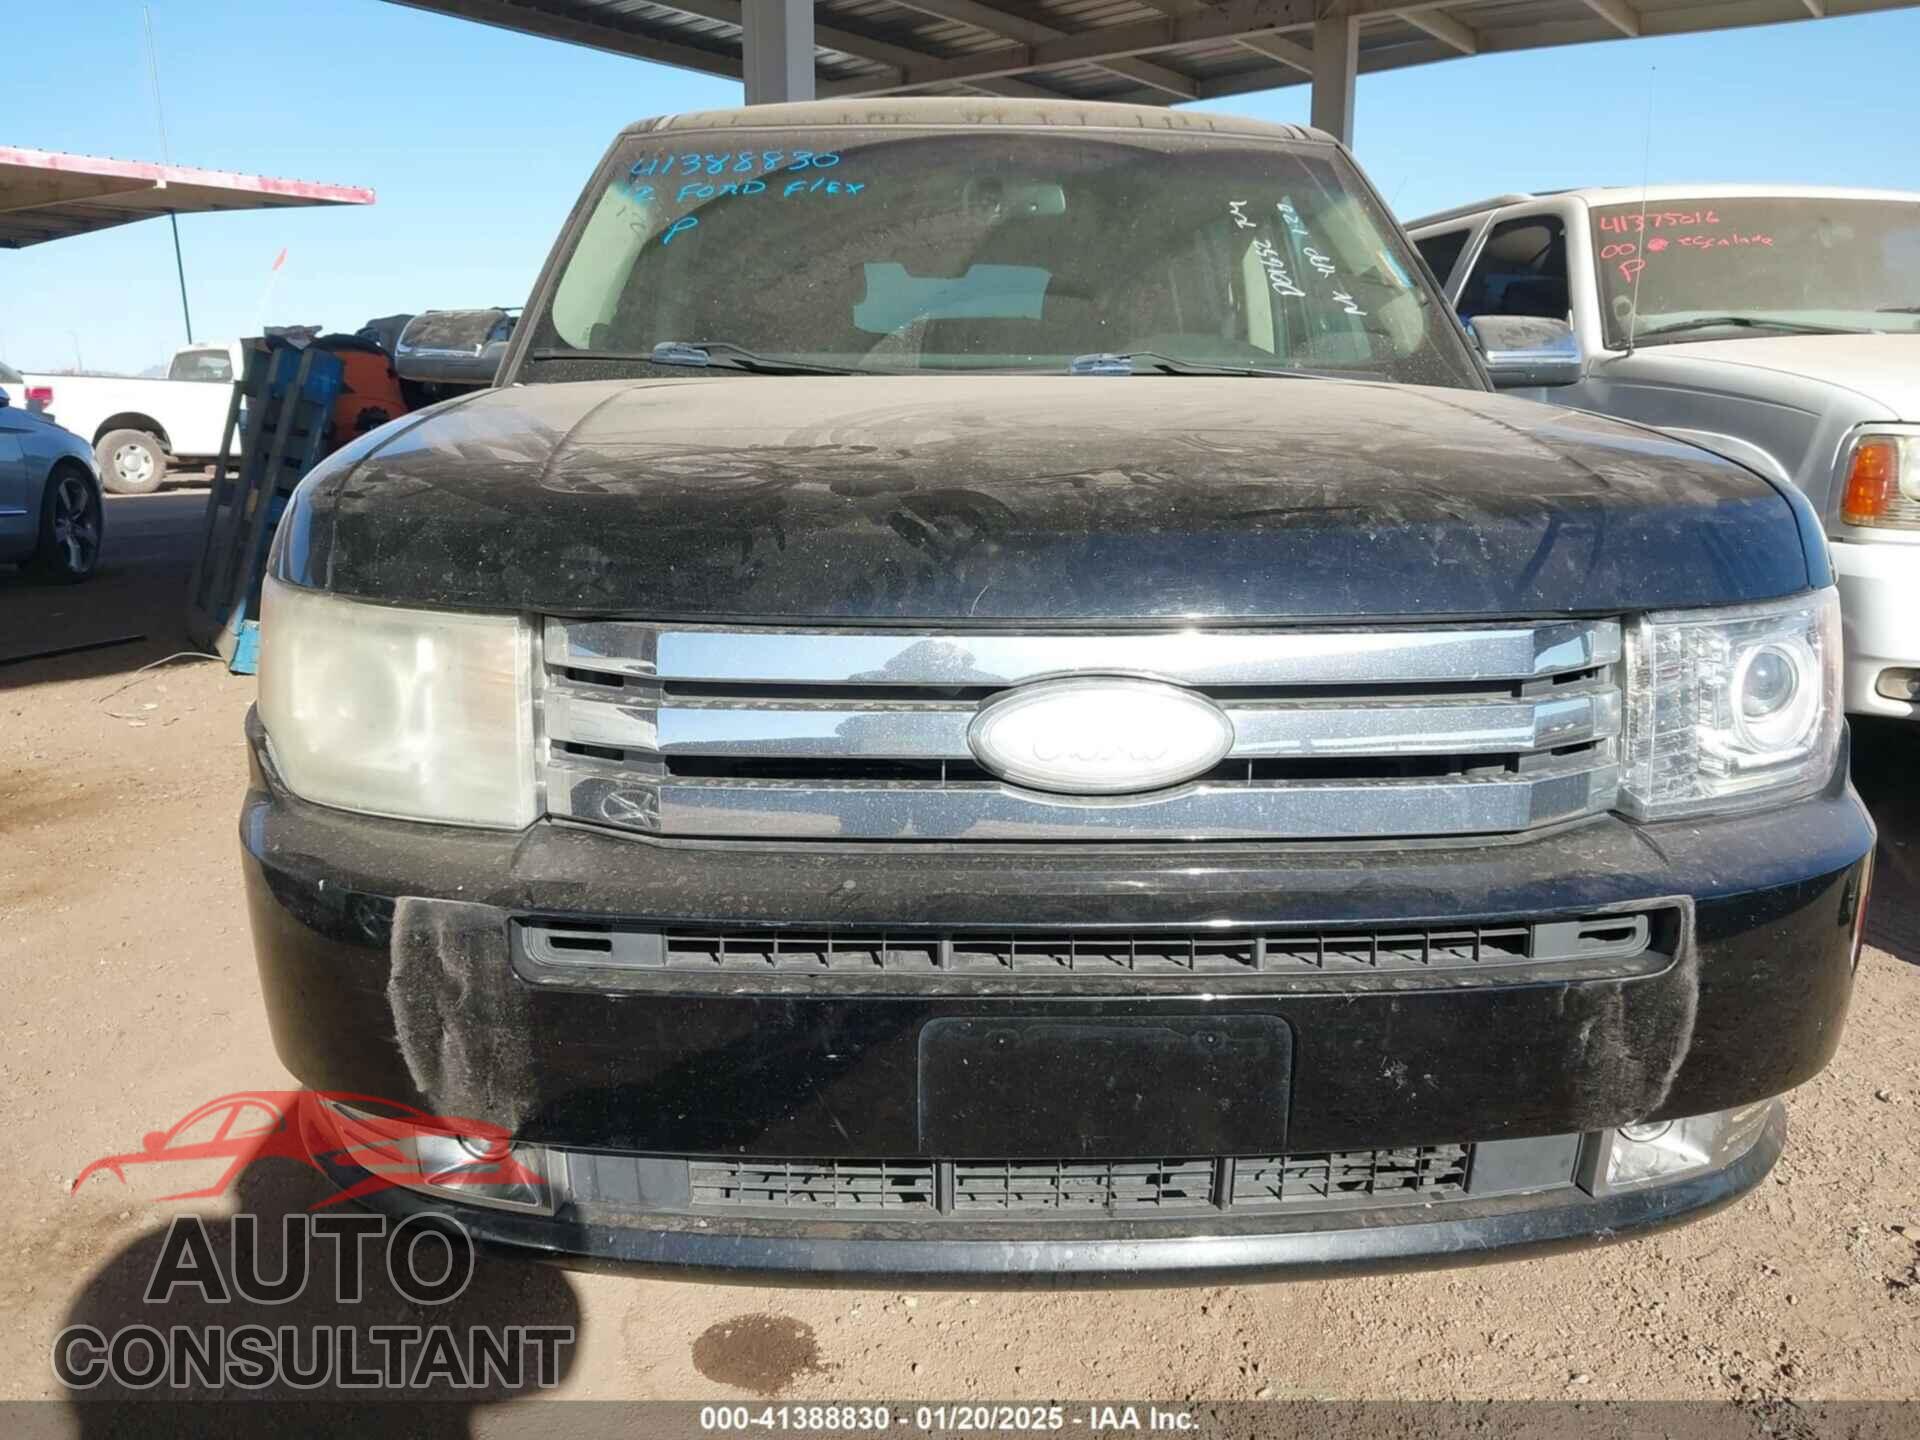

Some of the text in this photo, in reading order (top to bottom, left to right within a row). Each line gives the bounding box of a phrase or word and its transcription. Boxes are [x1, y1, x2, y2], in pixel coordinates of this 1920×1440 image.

[632, 151, 840, 176] 41388830
[676, 182, 767, 202] FORD
[663, 216, 698, 245] P
[1619, 259, 1646, 283] P
